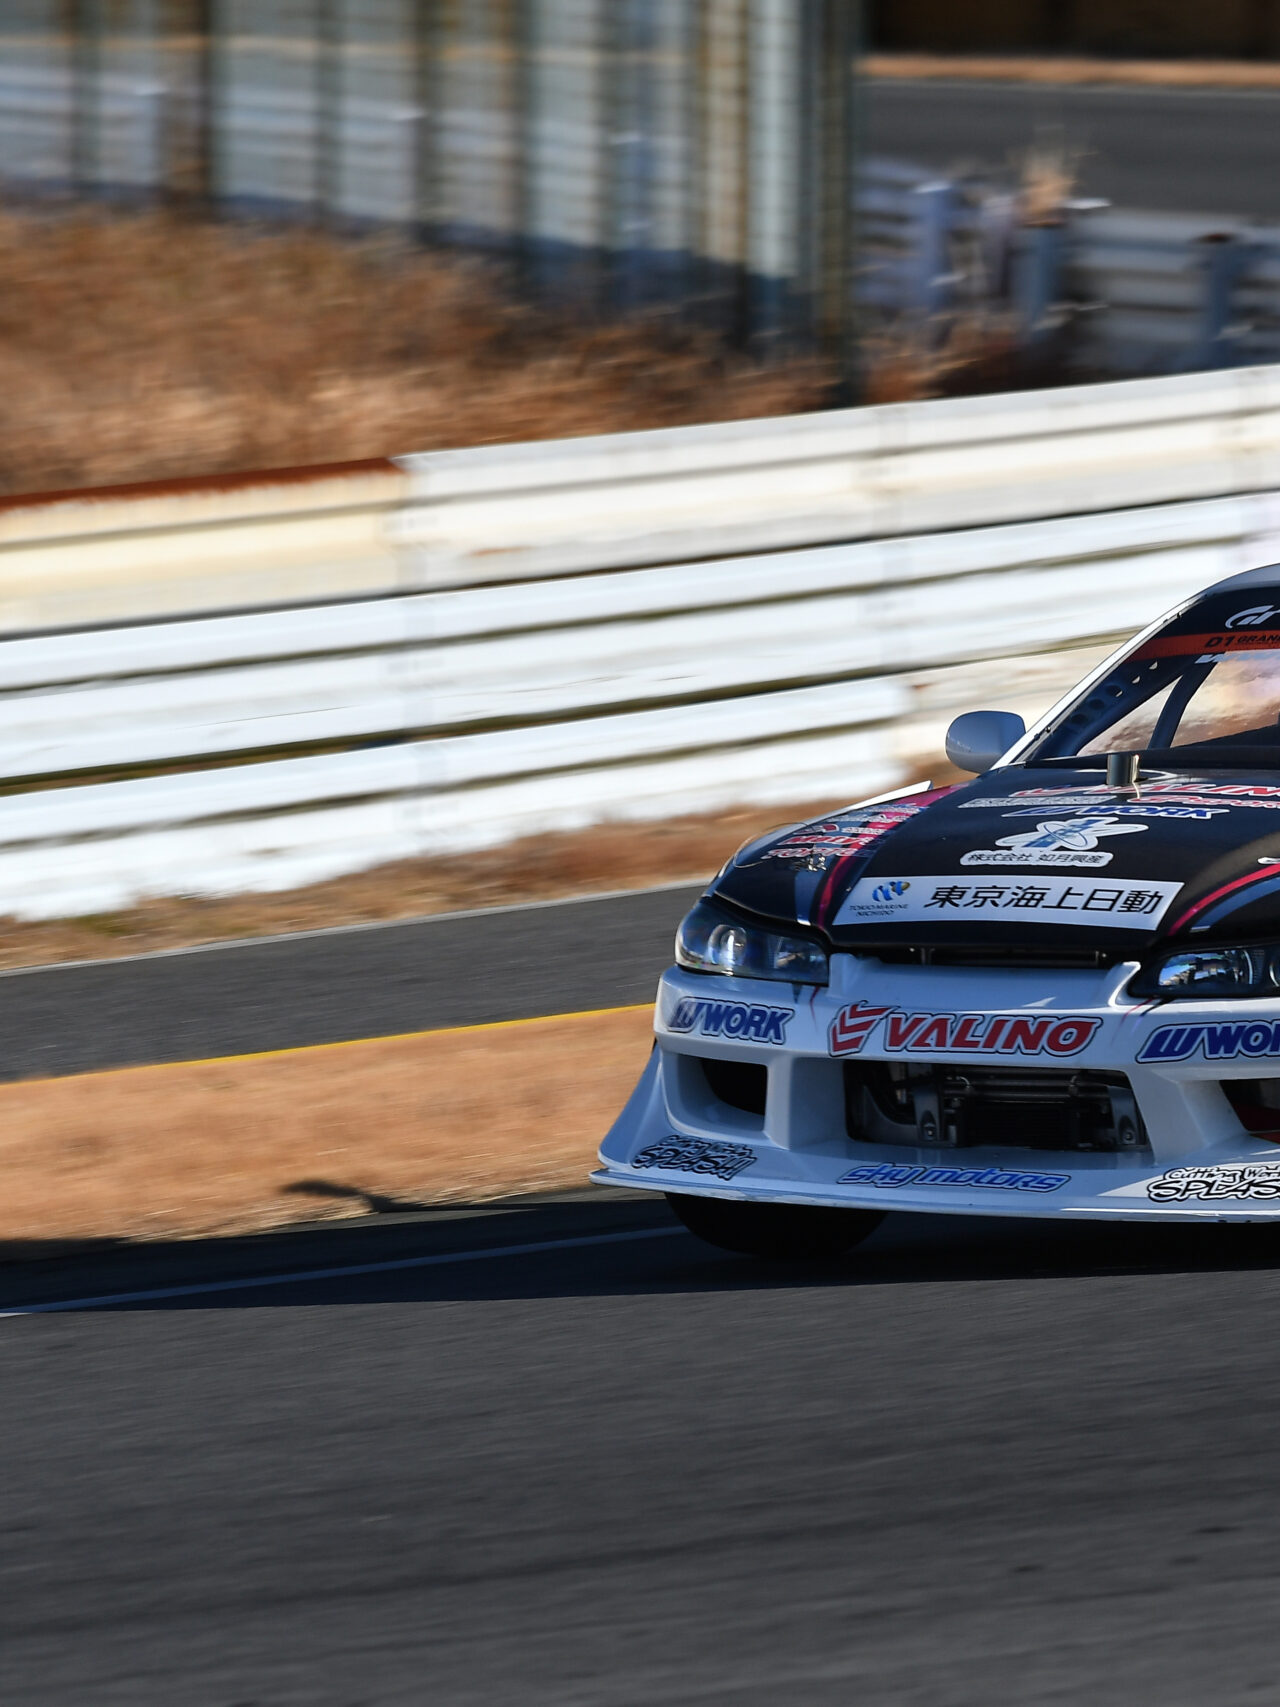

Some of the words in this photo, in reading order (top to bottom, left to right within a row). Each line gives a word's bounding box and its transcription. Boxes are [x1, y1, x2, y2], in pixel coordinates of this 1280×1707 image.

[1204, 635, 1236, 648] D1
[923, 884, 1165, 915] 東京海上日動
[703, 1003, 793, 1043] WORK
[886, 1014, 1102, 1055] VALINO
[838, 1163, 918, 1188] sky
[920, 1166, 1071, 1192] motors
